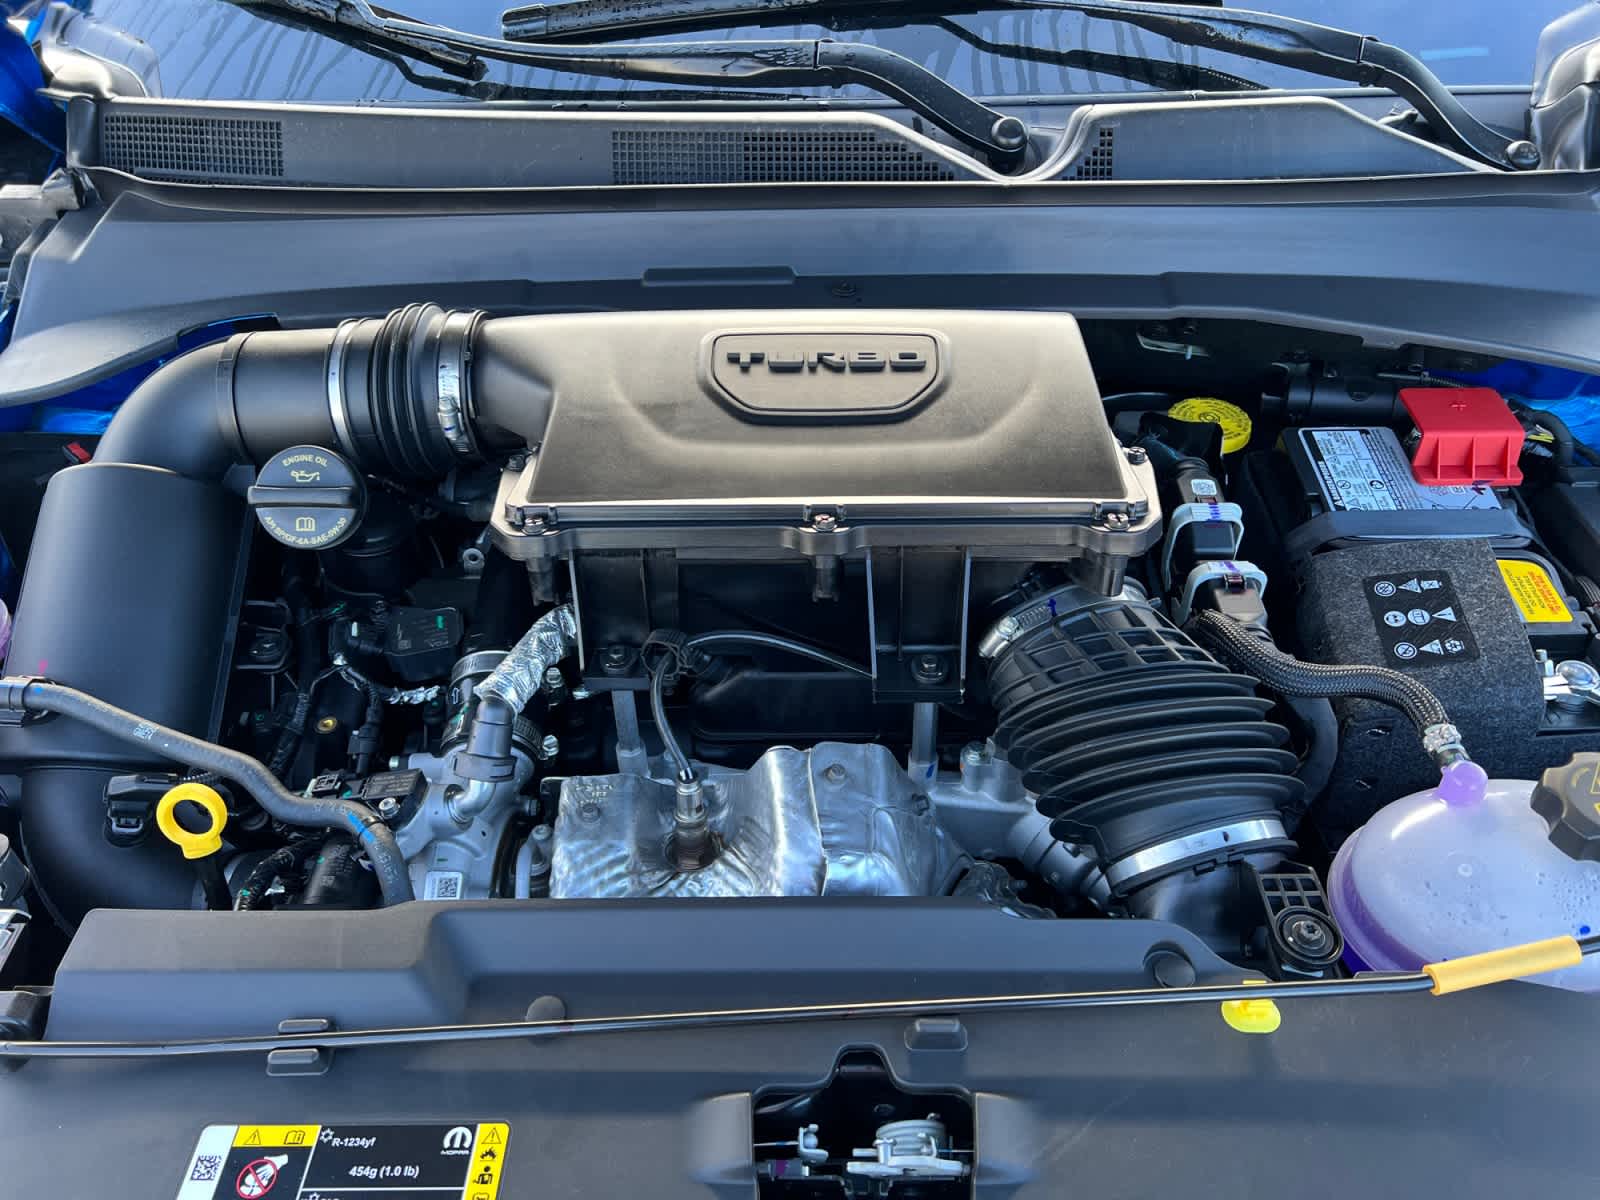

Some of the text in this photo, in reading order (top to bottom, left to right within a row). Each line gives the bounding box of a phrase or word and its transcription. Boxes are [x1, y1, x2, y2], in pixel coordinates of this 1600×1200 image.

[727, 351, 927, 373] TURBO
[282, 454, 328, 467] ENGINE OIL
[331, 1136, 377, 1149] R-1234yf
[348, 1165, 420, 1180] 454g (1.0 lb)
